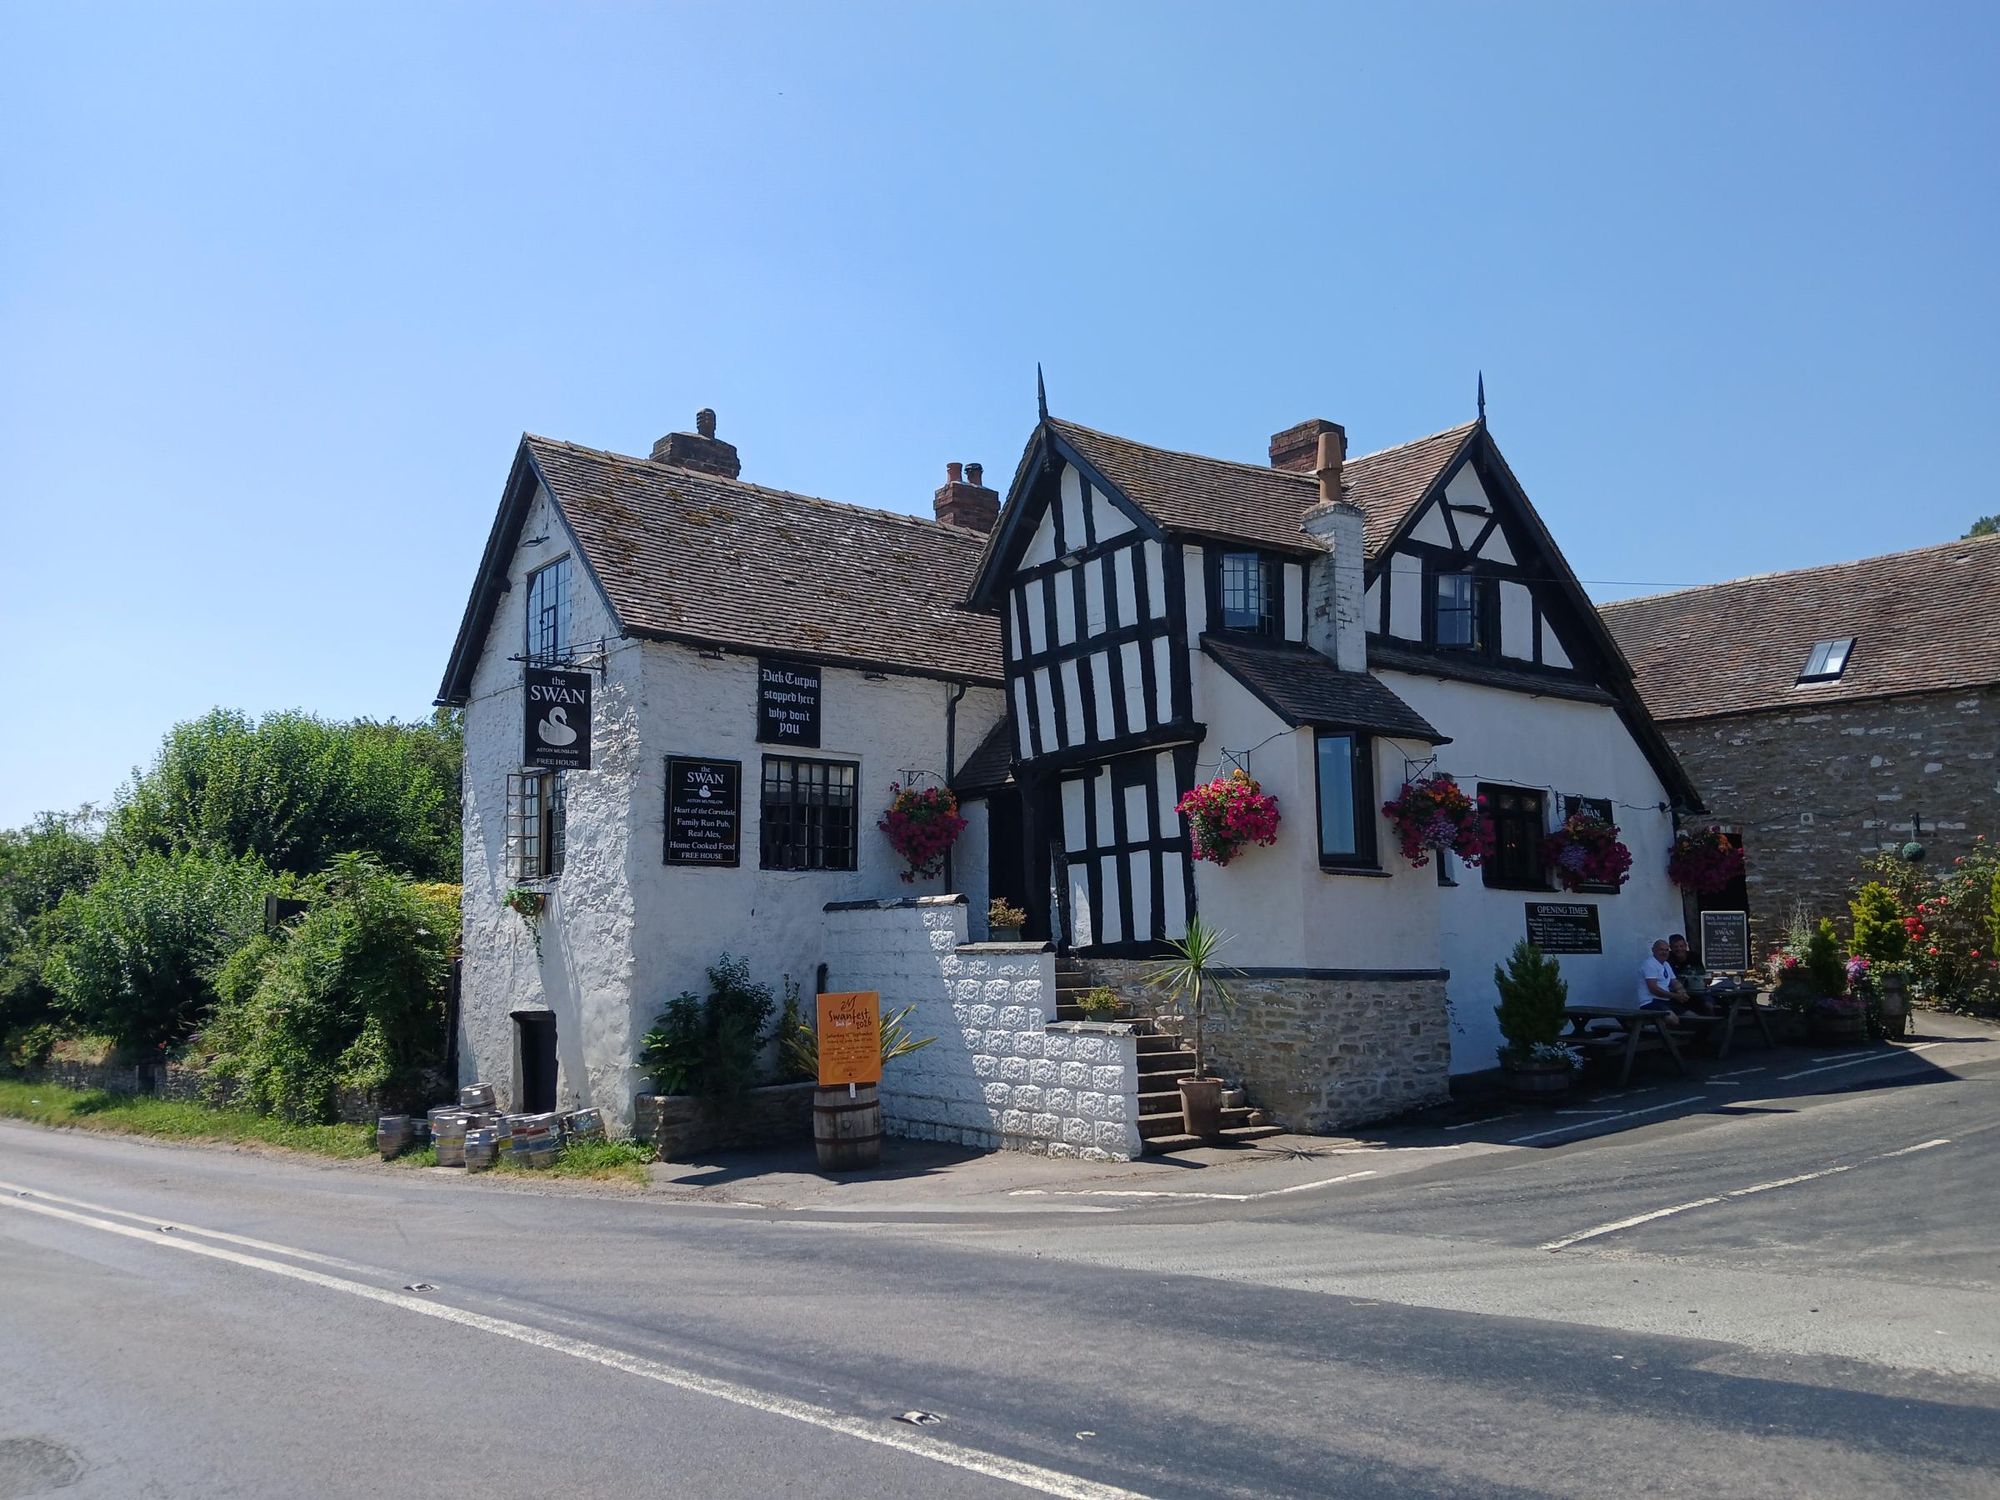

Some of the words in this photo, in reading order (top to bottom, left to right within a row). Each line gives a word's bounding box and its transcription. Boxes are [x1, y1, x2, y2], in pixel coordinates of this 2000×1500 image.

[551, 676, 566, 686] the
[762, 668, 784, 683] Dick
[785, 672, 818, 689] Turpin
[530, 685, 586, 704] SWAN
[763, 690, 797, 703] stopped
[797, 692, 815, 705] here
[768, 707, 787, 721] why
[789, 709, 810, 721] don't
[778, 722, 800, 737] you
[536, 757, 555, 765] FREE
[555, 758, 580, 767] HOUSE
[687, 772, 724, 784] SWAN
[673, 806, 690, 814] Heart
[677, 818, 699, 828] Family
[701, 819, 715, 827] Run
[716, 820, 731, 828] Pub,
[704, 831, 721, 839] Ales,
[670, 841, 690, 849] Home
[691, 842, 718, 850] Cooked
[1536, 905, 1567, 914] OPENING
[1568, 906, 1589, 915] TIMES
[828, 1008, 869, 1023] Swanfest
[856, 1018, 872, 1029] 2026
